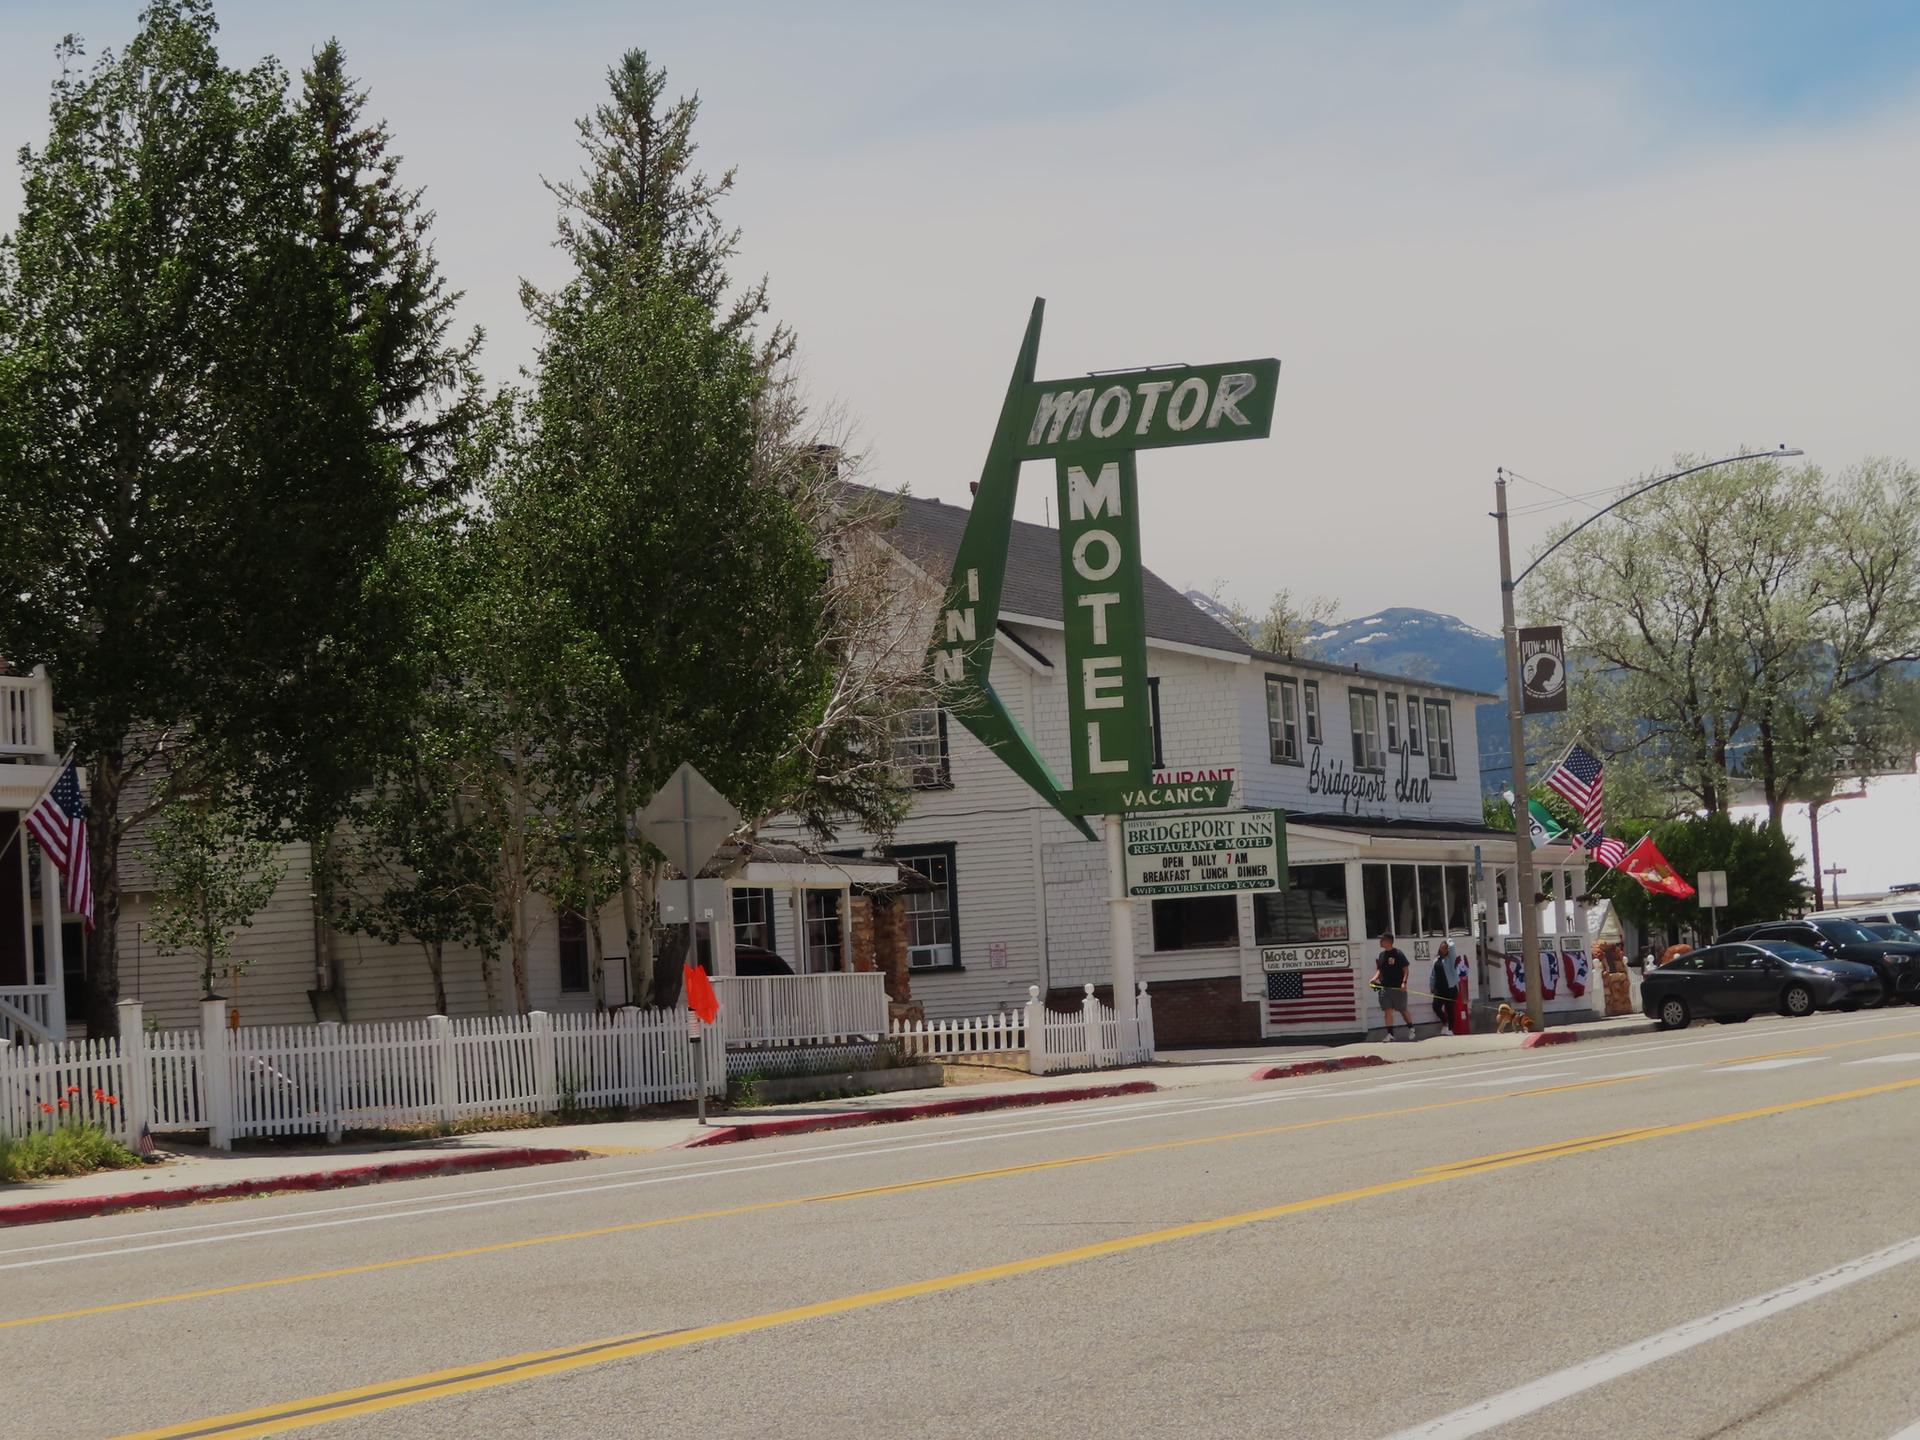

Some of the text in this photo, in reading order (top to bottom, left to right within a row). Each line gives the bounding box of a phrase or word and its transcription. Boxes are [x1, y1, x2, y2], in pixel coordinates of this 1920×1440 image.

[1027, 373, 1257, 445] MOTOR
[934, 568, 980, 681] INN
[1067, 462, 1129, 774] MOTEL
[1522, 639, 1563, 664] POW MIA
[1309, 740, 1432, 814] Bridgeport Inn
[1121, 785, 1218, 806] VACANCY
[1128, 820, 1273, 843] BRIDGEPORT INN
[1133, 837, 1270, 854] RESTAURANT MOTEL
[1162, 852, 1248, 868] OPEN DAILY 7 AM
[1143, 864, 1268, 883] BREAKFAST LUNCH DINNER
[1162, 884, 1204, 893] TOURIST
[1206, 882, 1230, 890] INFO
[1236, 881, 1256, 889] ECV
[1265, 948, 1347, 962] Motel Office
